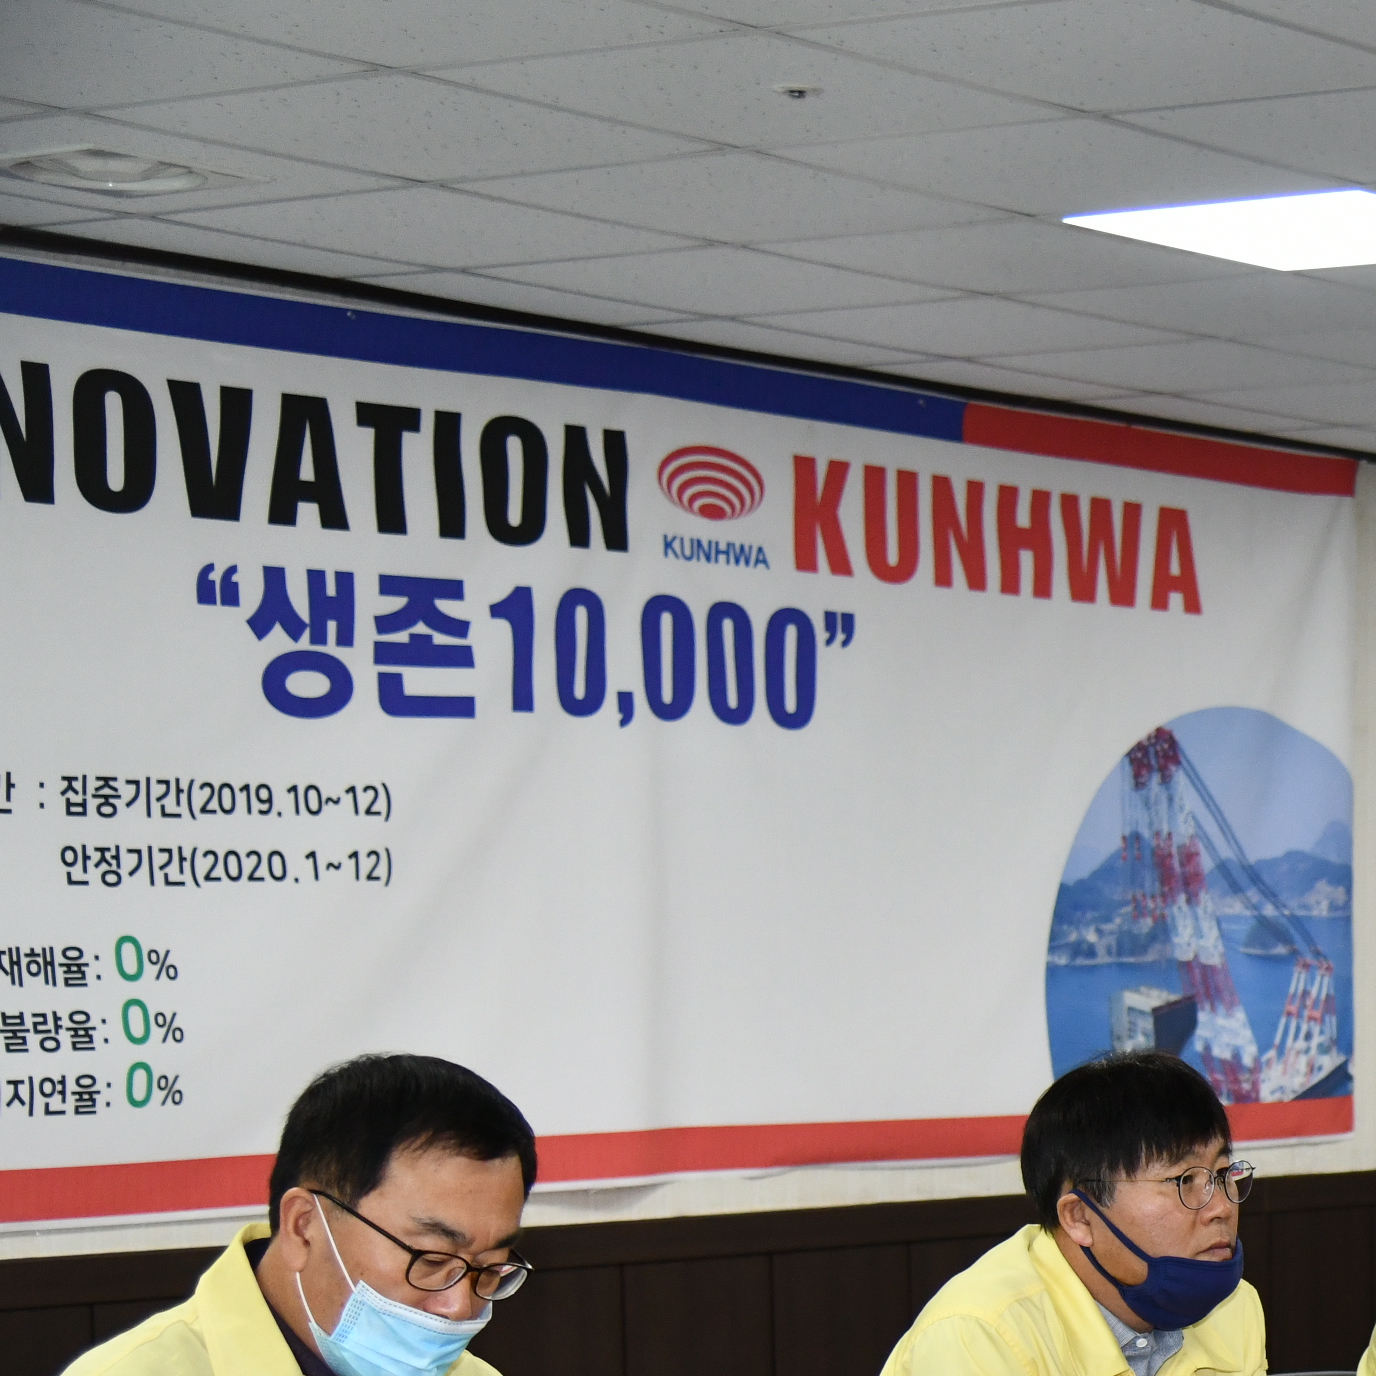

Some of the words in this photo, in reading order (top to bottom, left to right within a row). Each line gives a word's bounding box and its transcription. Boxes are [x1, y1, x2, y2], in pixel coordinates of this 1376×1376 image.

[0, 360, 629, 553] NOVATION
[662, 533, 770, 570] KUNHWA
[791, 453, 1203, 615] KUNHWA
[0, 1073, 113, 1118] 지연율:
